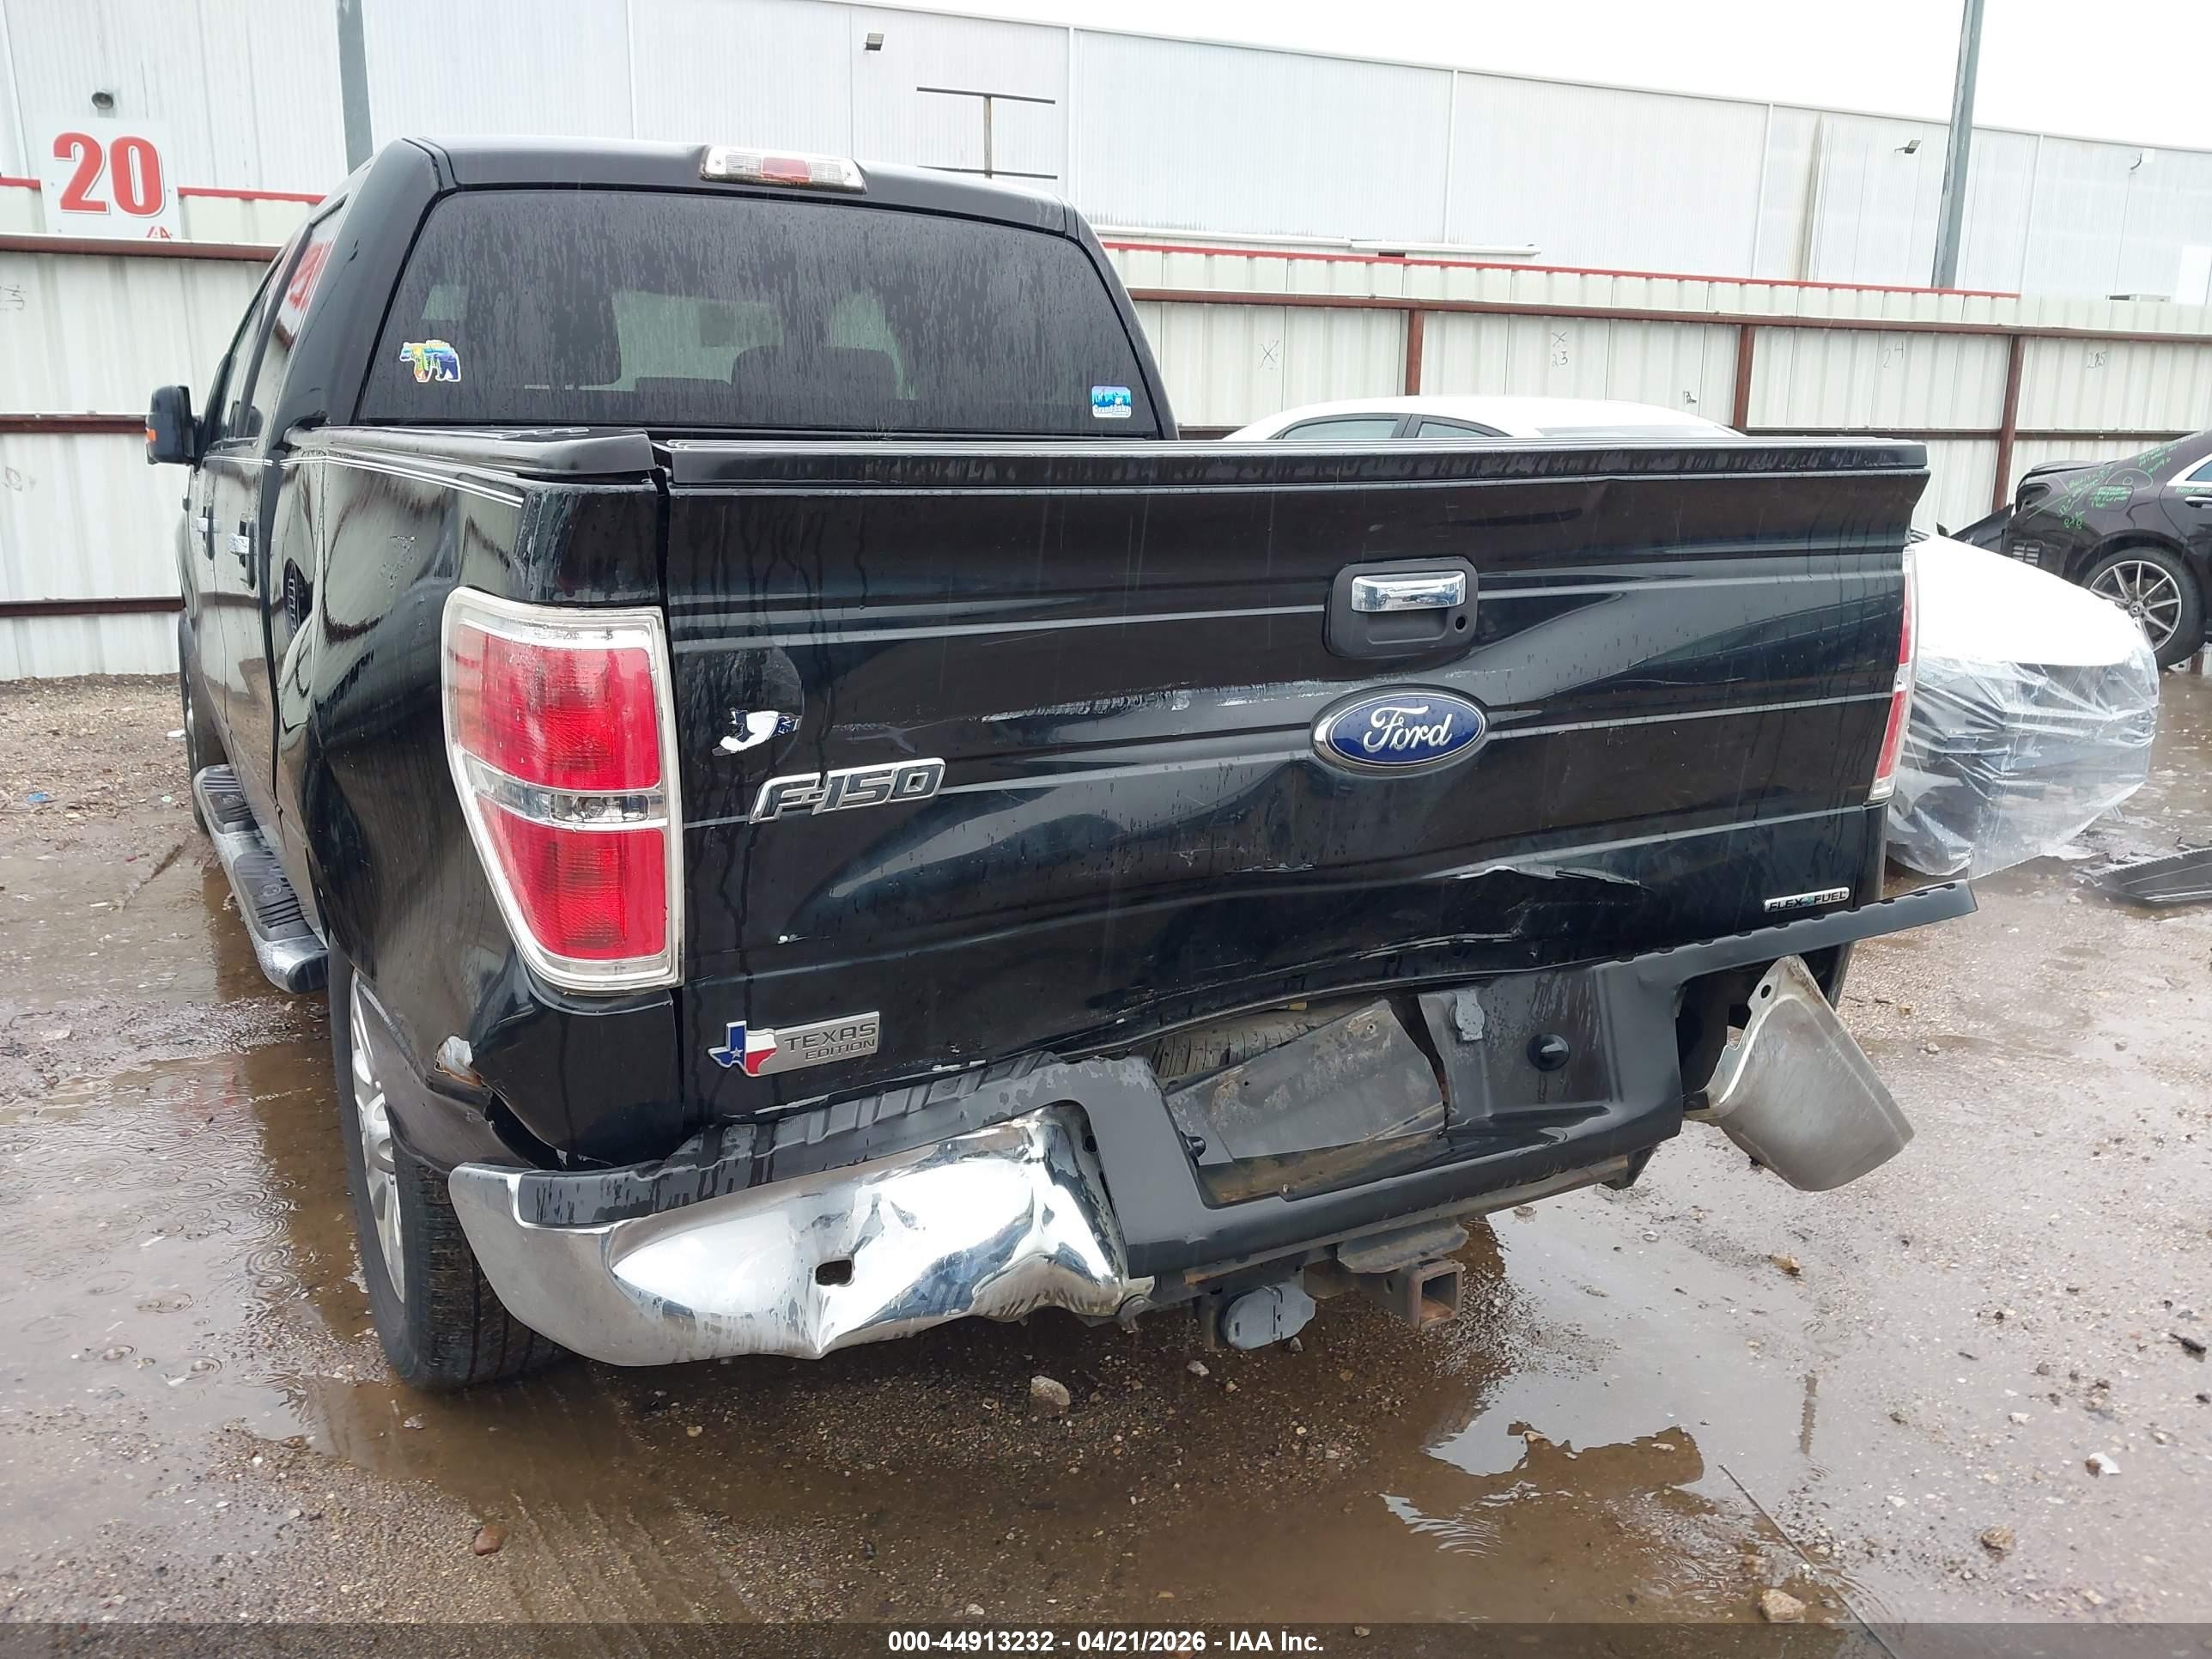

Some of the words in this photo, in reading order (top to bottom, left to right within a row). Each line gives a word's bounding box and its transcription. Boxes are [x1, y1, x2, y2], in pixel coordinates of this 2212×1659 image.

[52, 131, 166, 217] 20
[1364, 705, 1453, 753] Ford
[749, 757, 945, 824] F-150
[1769, 897, 1804, 910] FLEX
[1814, 890, 1847, 904] FUEL
[784, 1022, 877, 1052] TEXAS
[805, 1038, 876, 1060] EDITION
